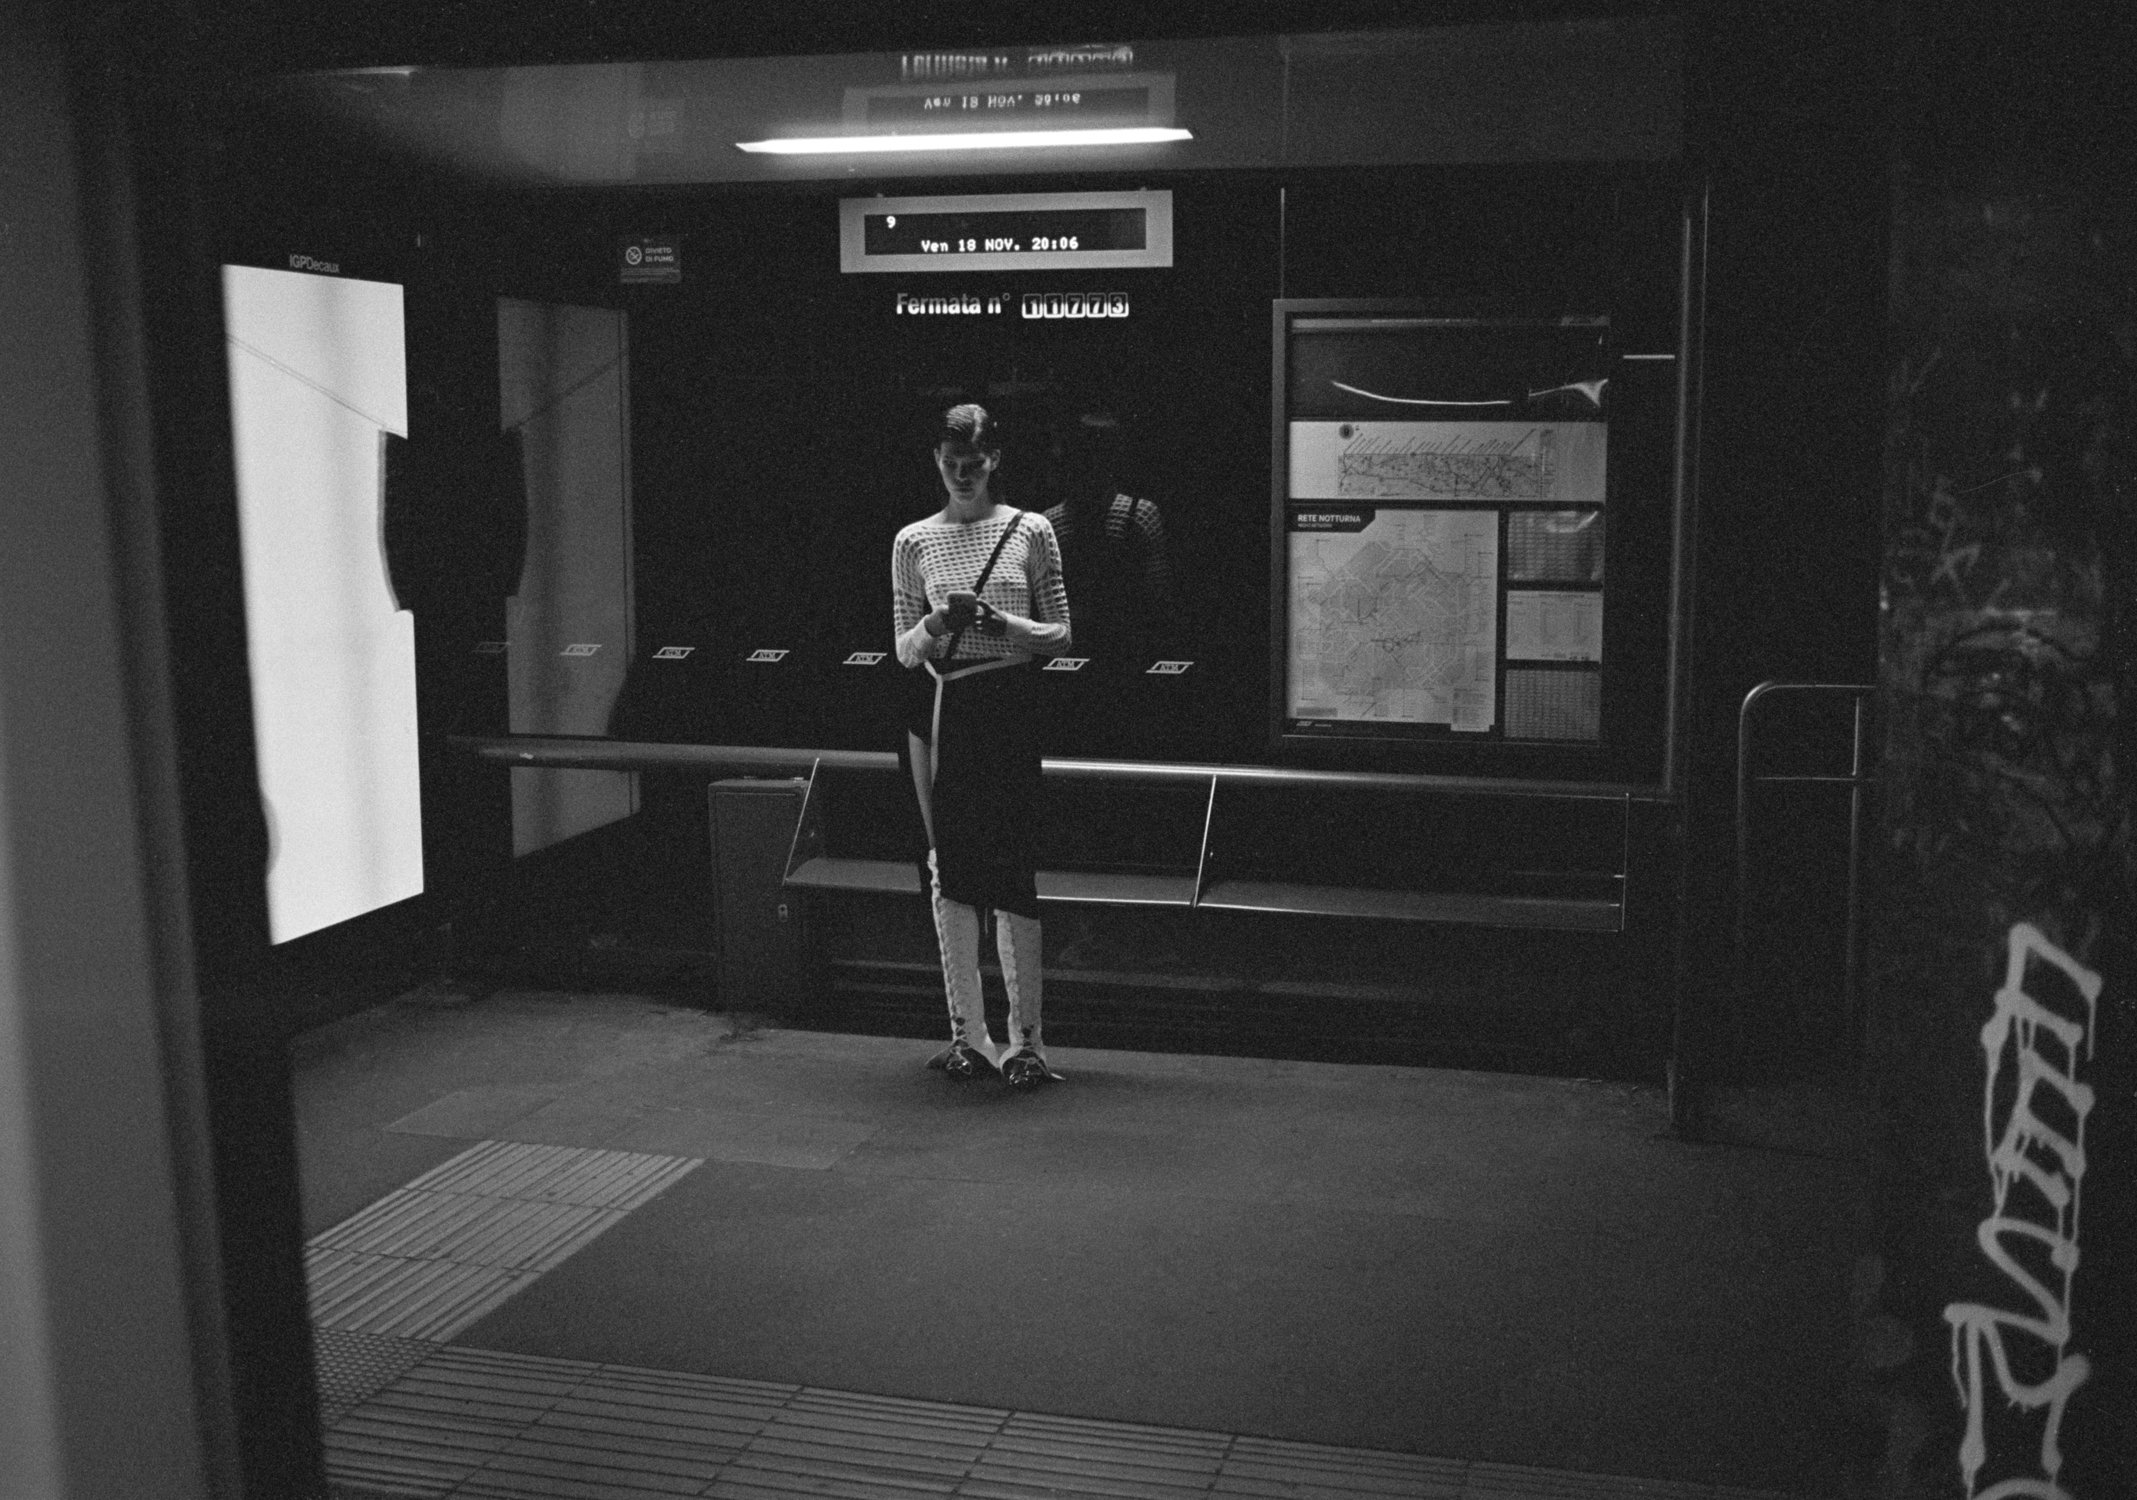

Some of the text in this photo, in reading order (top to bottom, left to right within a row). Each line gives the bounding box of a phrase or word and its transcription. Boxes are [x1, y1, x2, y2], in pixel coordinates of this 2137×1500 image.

[886, 215, 896, 229] 9
[921, 236, 1079, 253] Ven 18 NOV. 20:06
[289, 253, 340, 273] IGPDecaux
[896, 291, 1127, 317] Fermata n° 11773
[1297, 513, 1361, 523] RETE NOTTURNA
